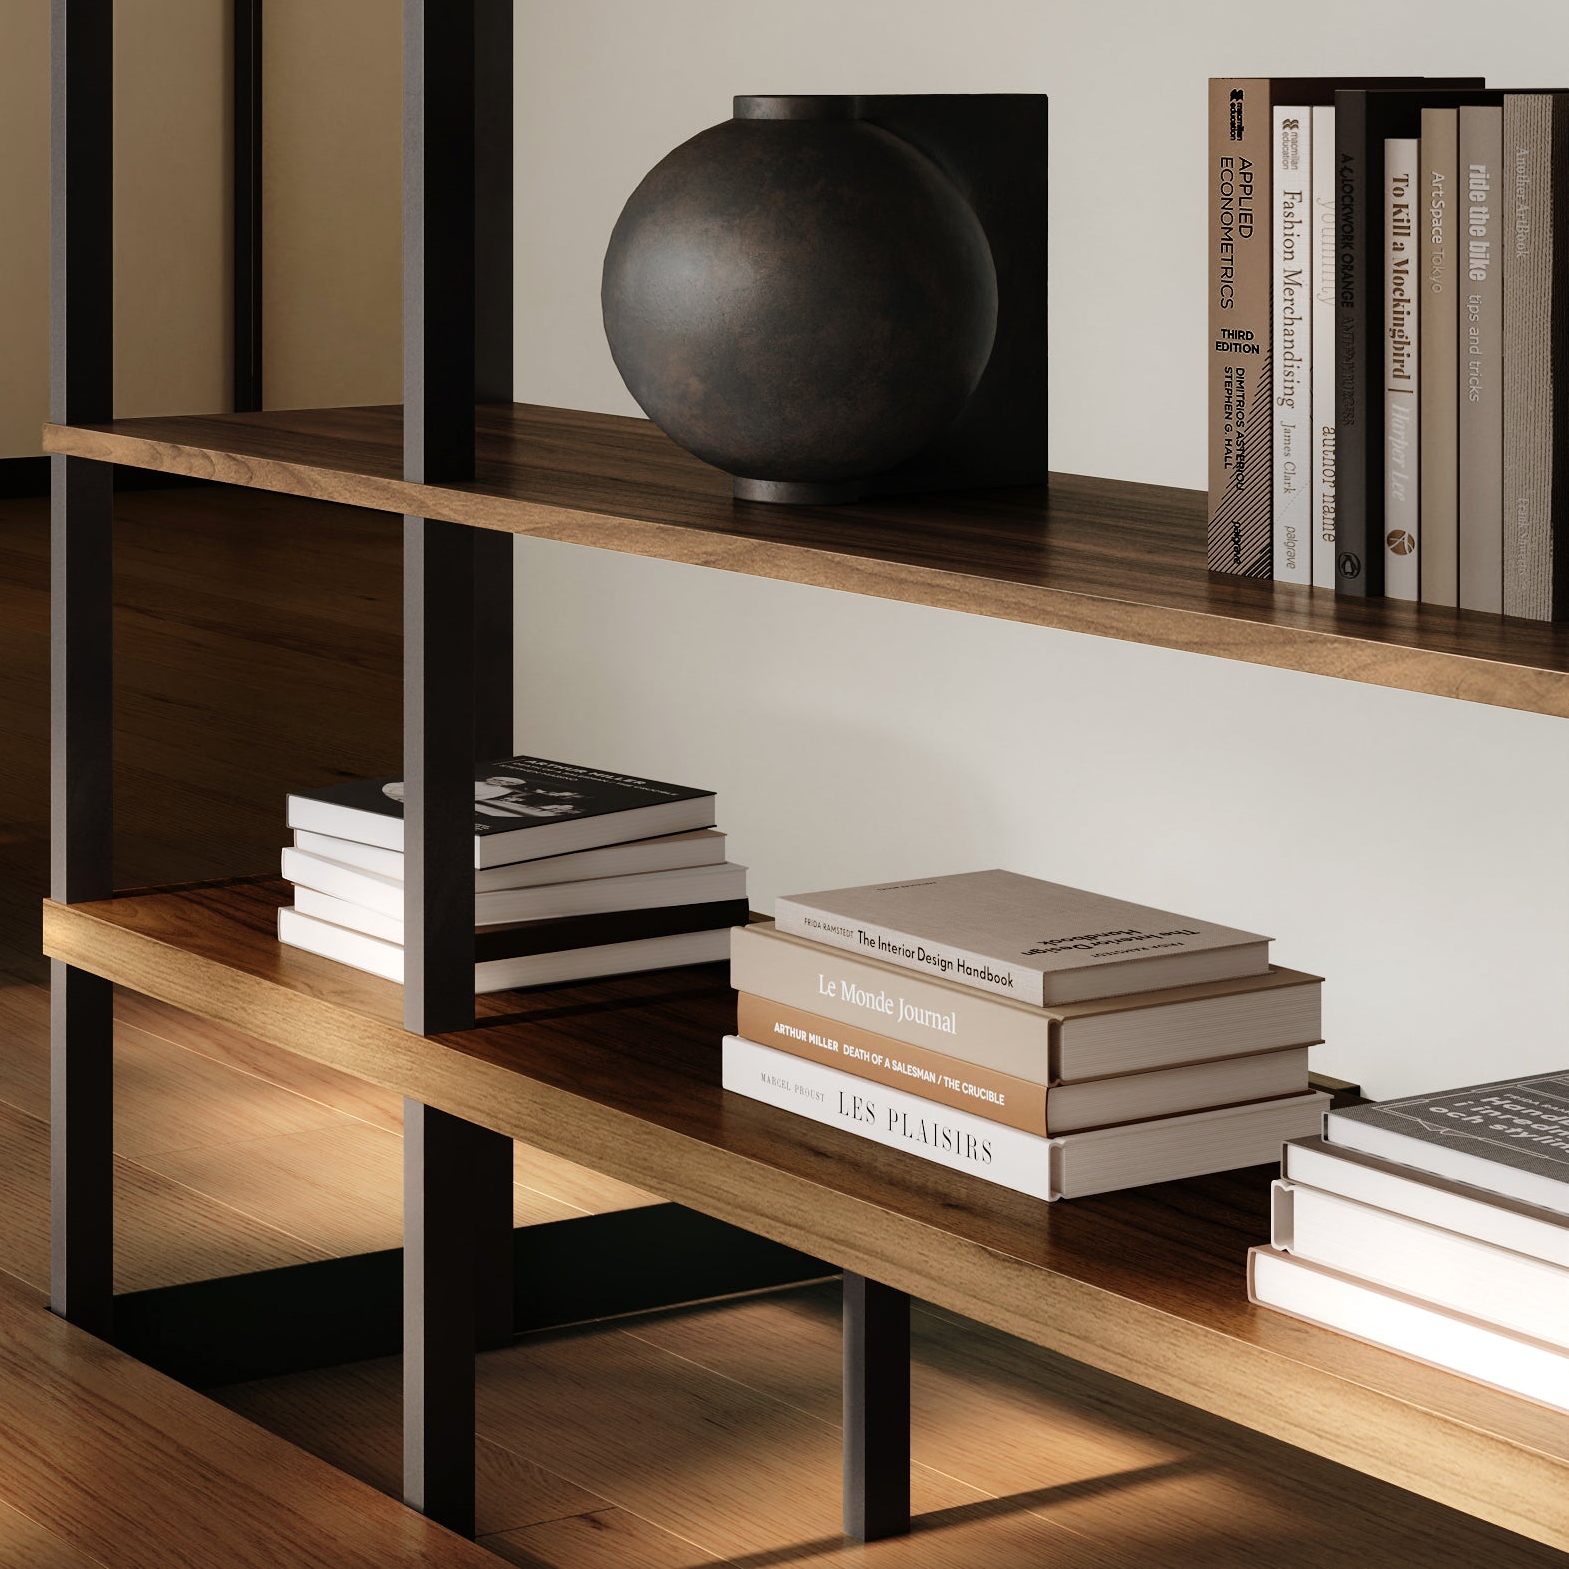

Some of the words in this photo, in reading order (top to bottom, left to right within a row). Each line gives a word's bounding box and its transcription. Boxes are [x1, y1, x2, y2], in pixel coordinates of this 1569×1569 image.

[1341, 153, 1354, 164] A
[1516, 147, 1530, 197] Another
[1239, 156, 1253, 239] APPLIED
[1392, 174, 1409, 198] To
[1431, 171, 1445, 197] Art
[1469, 164, 1490, 202] ride
[1220, 157, 1233, 309] ECONOMETRICS
[1283, 190, 1303, 262] Fashion
[1392, 203, 1411, 237] Kill
[1430, 198, 1445, 244] Space
[1469, 205, 1490, 237] the
[1392, 242, 1405, 252] a
[1469, 241, 1490, 281] bike
[1341, 254, 1354, 309] ORANGE
[1430, 247, 1446, 294] Tokyo
[1389, 257, 1411, 379] Mockingbird
[1467, 294, 1482, 322] tips
[1215, 341, 1260, 354] EDITION
[1221, 329, 1254, 341] THIRD
[1277, 268, 1303, 409] Merchandising
[1469, 326, 1483, 354] and
[1224, 366, 1232, 421] STEPHEN
[1236, 367, 1245, 428] DIMITRIOS
[1469, 360, 1482, 402] tricks
[1224, 438, 1232, 469] HALL
[1281, 420, 1296, 458] James
[1388, 403, 1410, 468] Harper
[1284, 461, 1296, 493] Clark
[1392, 472, 1408, 502] Lee
[1323, 493, 1335, 543] name
[1284, 525, 1295, 570] palgrave
[587, 771, 646, 785] MILLER
[804, 917, 822, 930] FRIDA
[823, 922, 854, 939] RAMSTEDT
[858, 930, 876, 948] The
[878, 935, 915, 960] Interior
[917, 947, 953, 972] Design
[957, 958, 1014, 989] Handbook
[818, 973, 836, 996] Le
[840, 980, 894, 1015] Monde
[897, 997, 957, 1035] Journal
[773, 1022, 807, 1042] ARTHUR
[808, 1032, 839, 1052] MILLER
[843, 1044, 870, 1063] DEATH
[871, 1053, 883, 1066] OF
[884, 1058, 891, 1069] A
[892, 1060, 936, 1084] SALESMAN
[943, 1076, 961, 1092] THE
[962, 1082, 1005, 1106] CRUCIBLE
[760, 1072, 791, 1091] MARCEL
[794, 1084, 825, 1103] PROUST
[838, 1090, 876, 1126] LES
[887, 1106, 993, 1165] PLAISIRS
[1429, 1106, 1484, 1124] och
